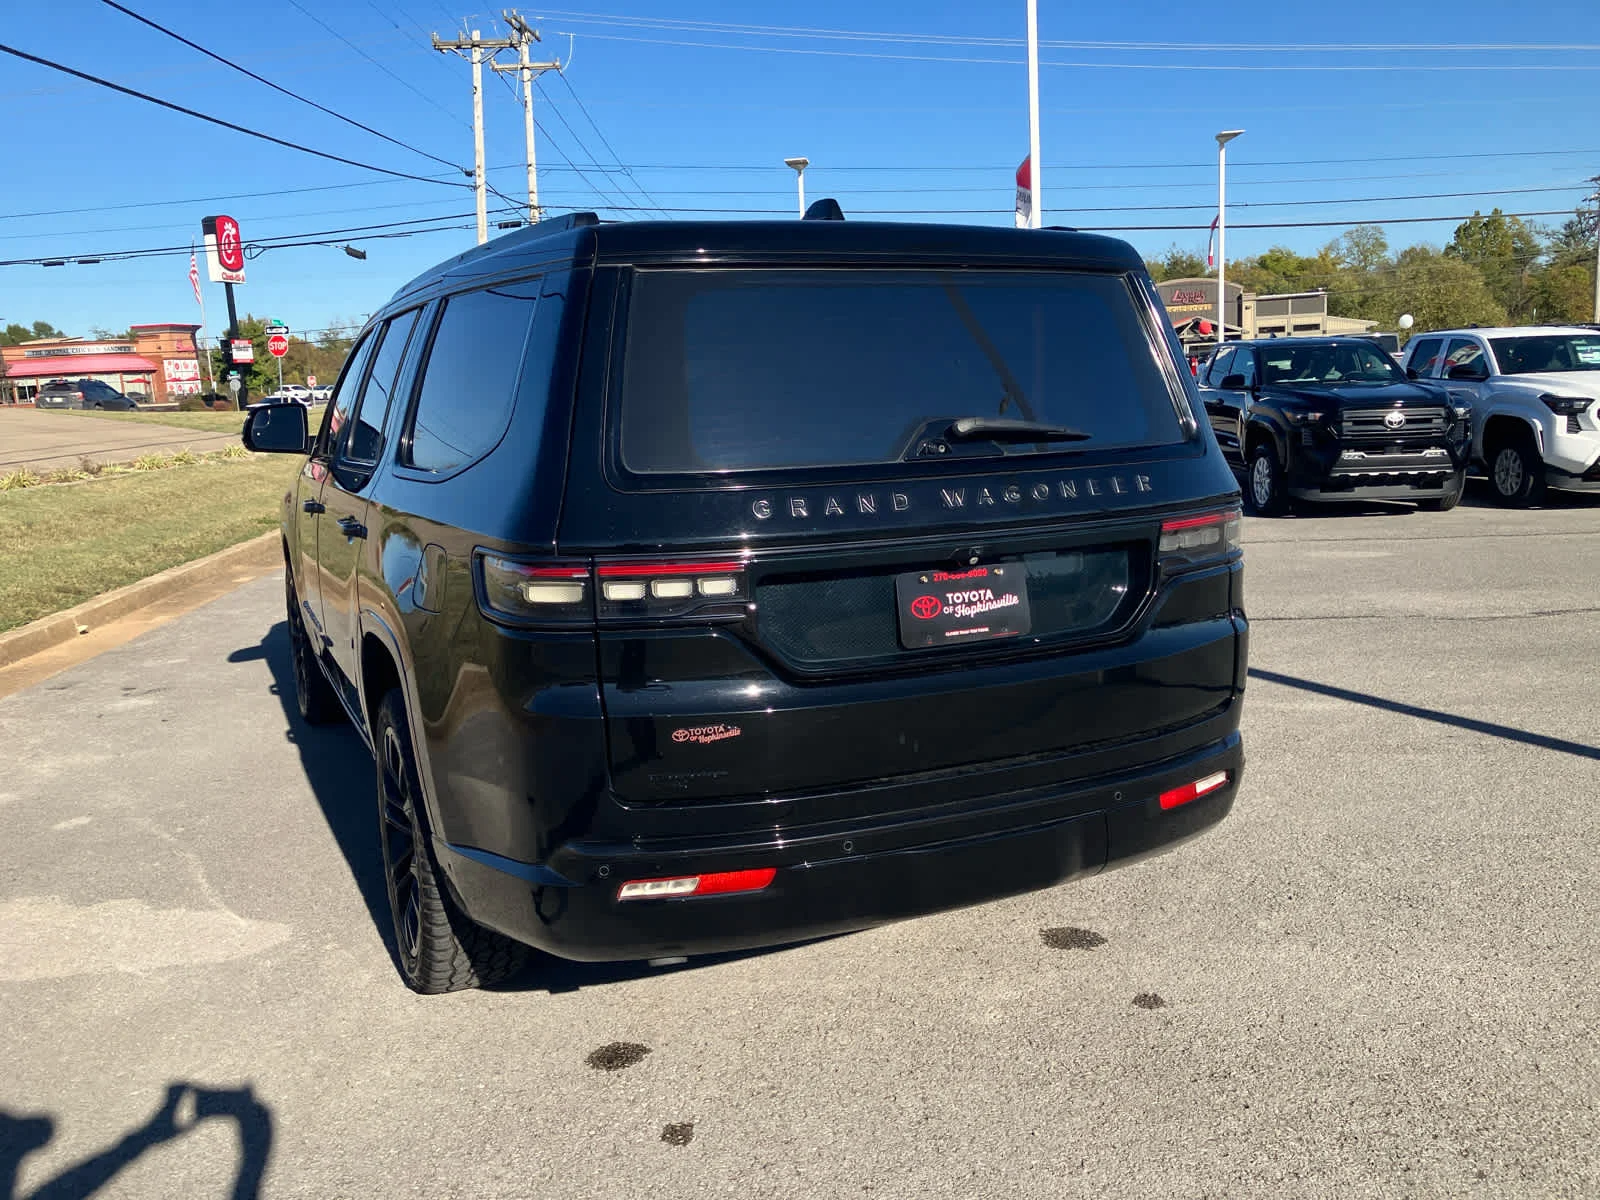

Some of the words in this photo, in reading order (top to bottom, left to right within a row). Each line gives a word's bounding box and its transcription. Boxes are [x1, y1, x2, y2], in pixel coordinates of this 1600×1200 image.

[269, 341, 287, 350] STOP
[752, 490, 909, 519] GRAND
[939, 474, 1151, 508] WAGONEER
[946, 589, 994, 605] TOYOTA
[943, 606, 954, 614] OF
[954, 593, 1020, 618] Hopkinsville
[689, 725, 725, 736] TOYOTA
